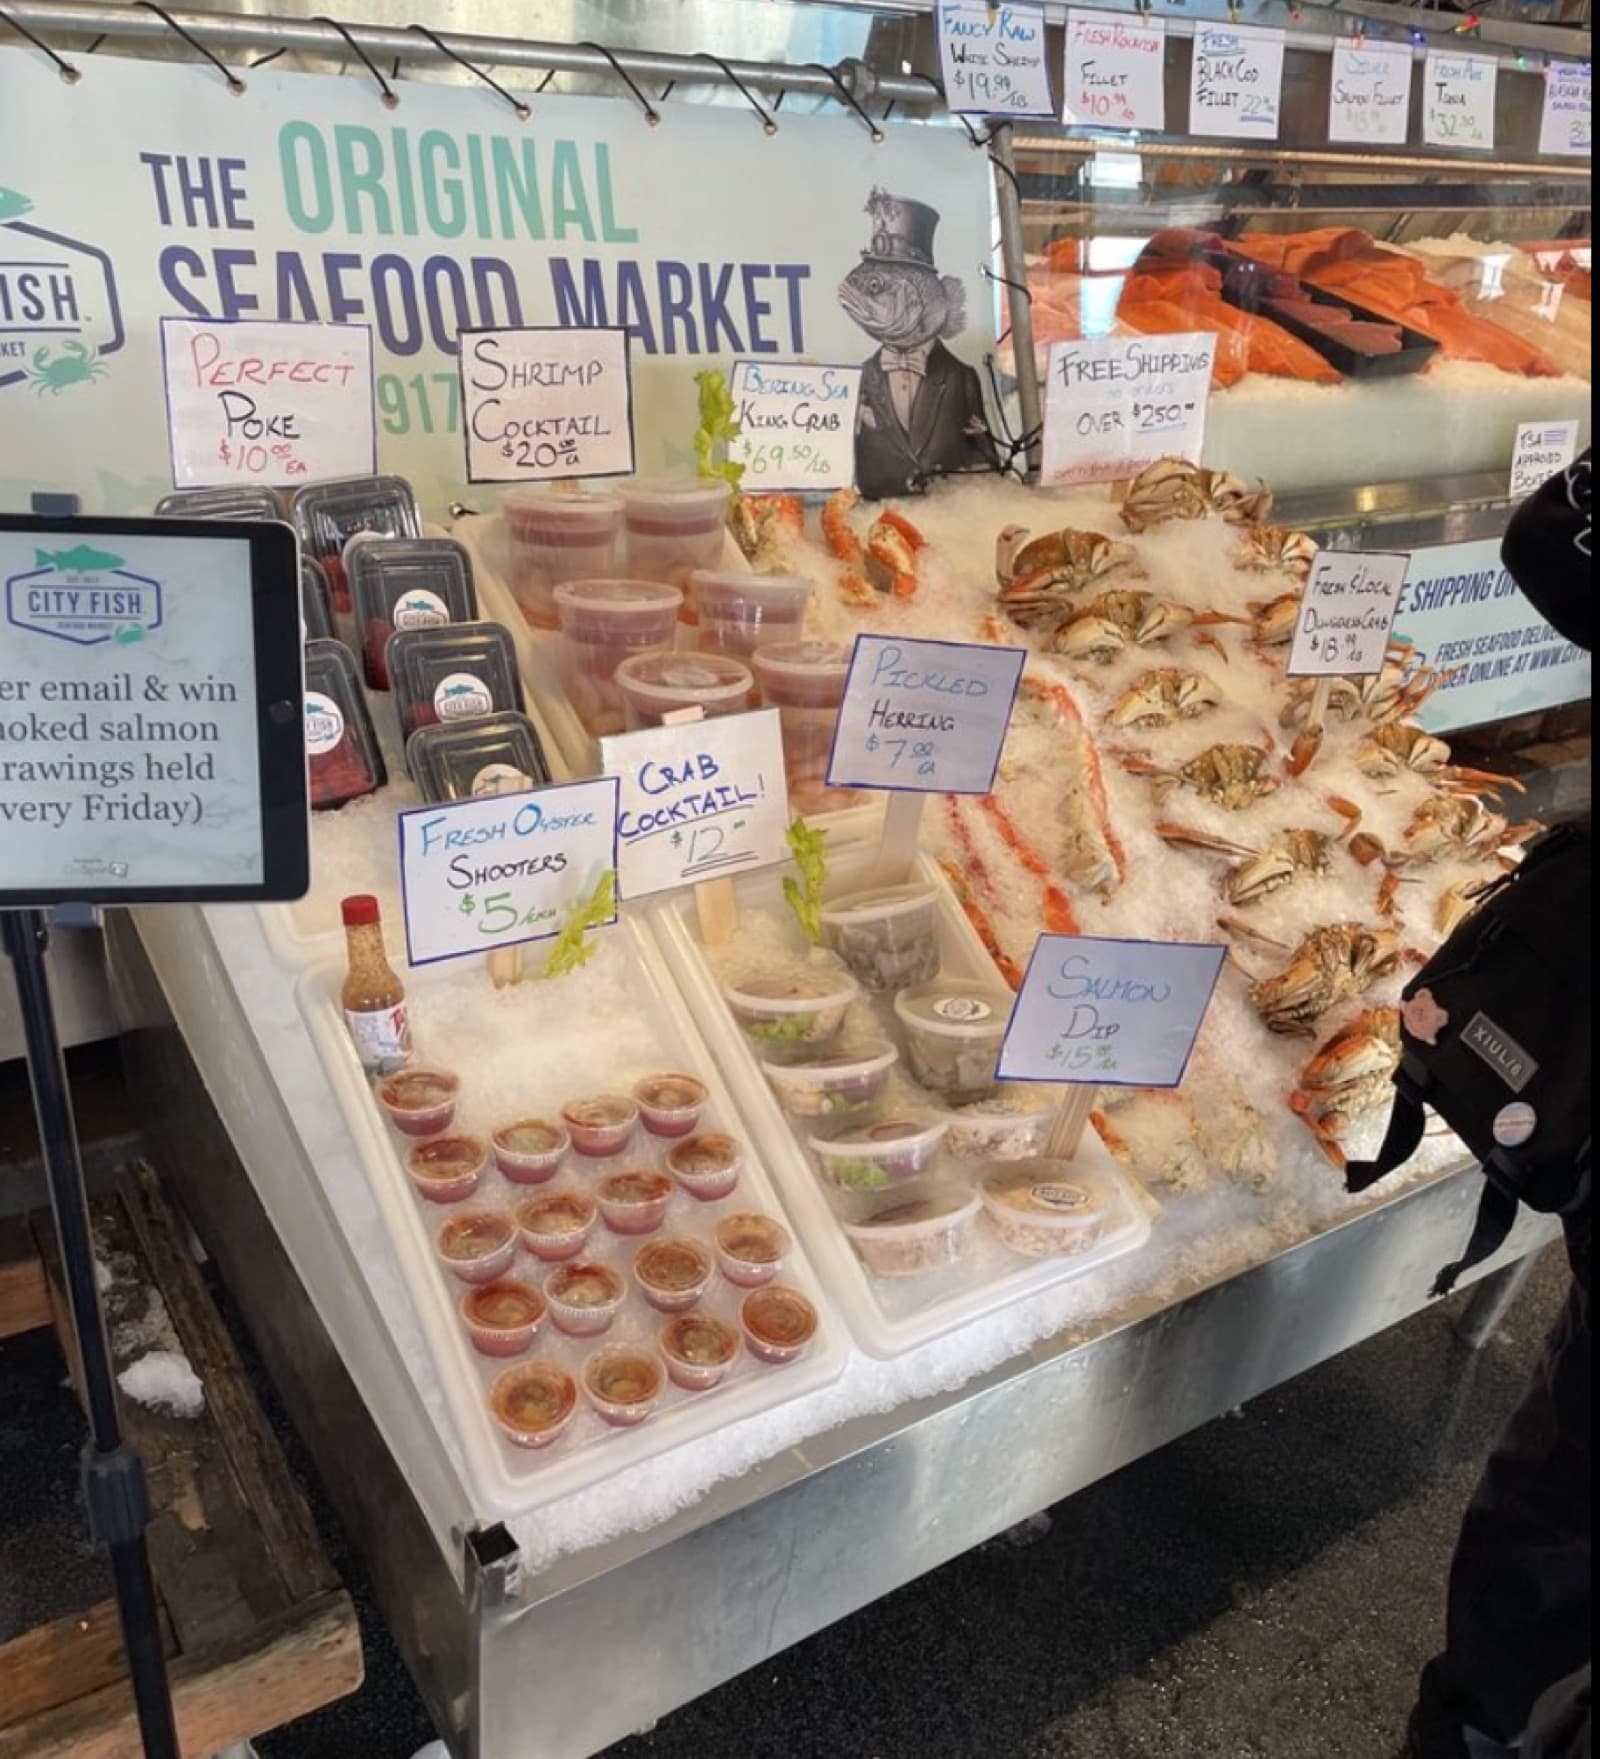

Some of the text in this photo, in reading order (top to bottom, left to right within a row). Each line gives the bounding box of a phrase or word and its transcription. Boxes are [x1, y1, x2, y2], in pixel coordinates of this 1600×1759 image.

[1081, 59, 1128, 86] FILLET
[140, 120, 638, 243] THE ORIGINAL
[159, 245, 811, 356] SEAFOOD MARKET
[190, 333, 355, 388] PERFECT
[471, 339, 604, 391] SHRIMP
[1057, 342, 1210, 387] FREE SHIPPING
[218, 390, 301, 440] POKE
[472, 398, 612, 442] COCKTAIL
[740, 399, 840, 433] KING CRAB
[1076, 411, 1125, 436] OVER
[28, 591, 141, 614] CITY FISH
[1410, 570, 1494, 613] SHIPPING
[40, 674, 132, 701] email
[144, 675, 169, 701] &
[179, 675, 237, 701] win
[871, 646, 988, 696] PICKLED
[100, 713, 219, 742] salmon
[867, 699, 954, 731] HERRING
[145, 753, 214, 780] held
[639, 754, 720, 795] CRAB
[82, 793, 203, 827] Friday)
[618, 773, 765, 837] COCKTAIL!
[420, 803, 597, 857] FRESH OYSTER
[446, 852, 568, 890] SHOOTERS
[1047, 955, 1172, 1003] SALMON
[1060, 1003, 1121, 1040] DIP
